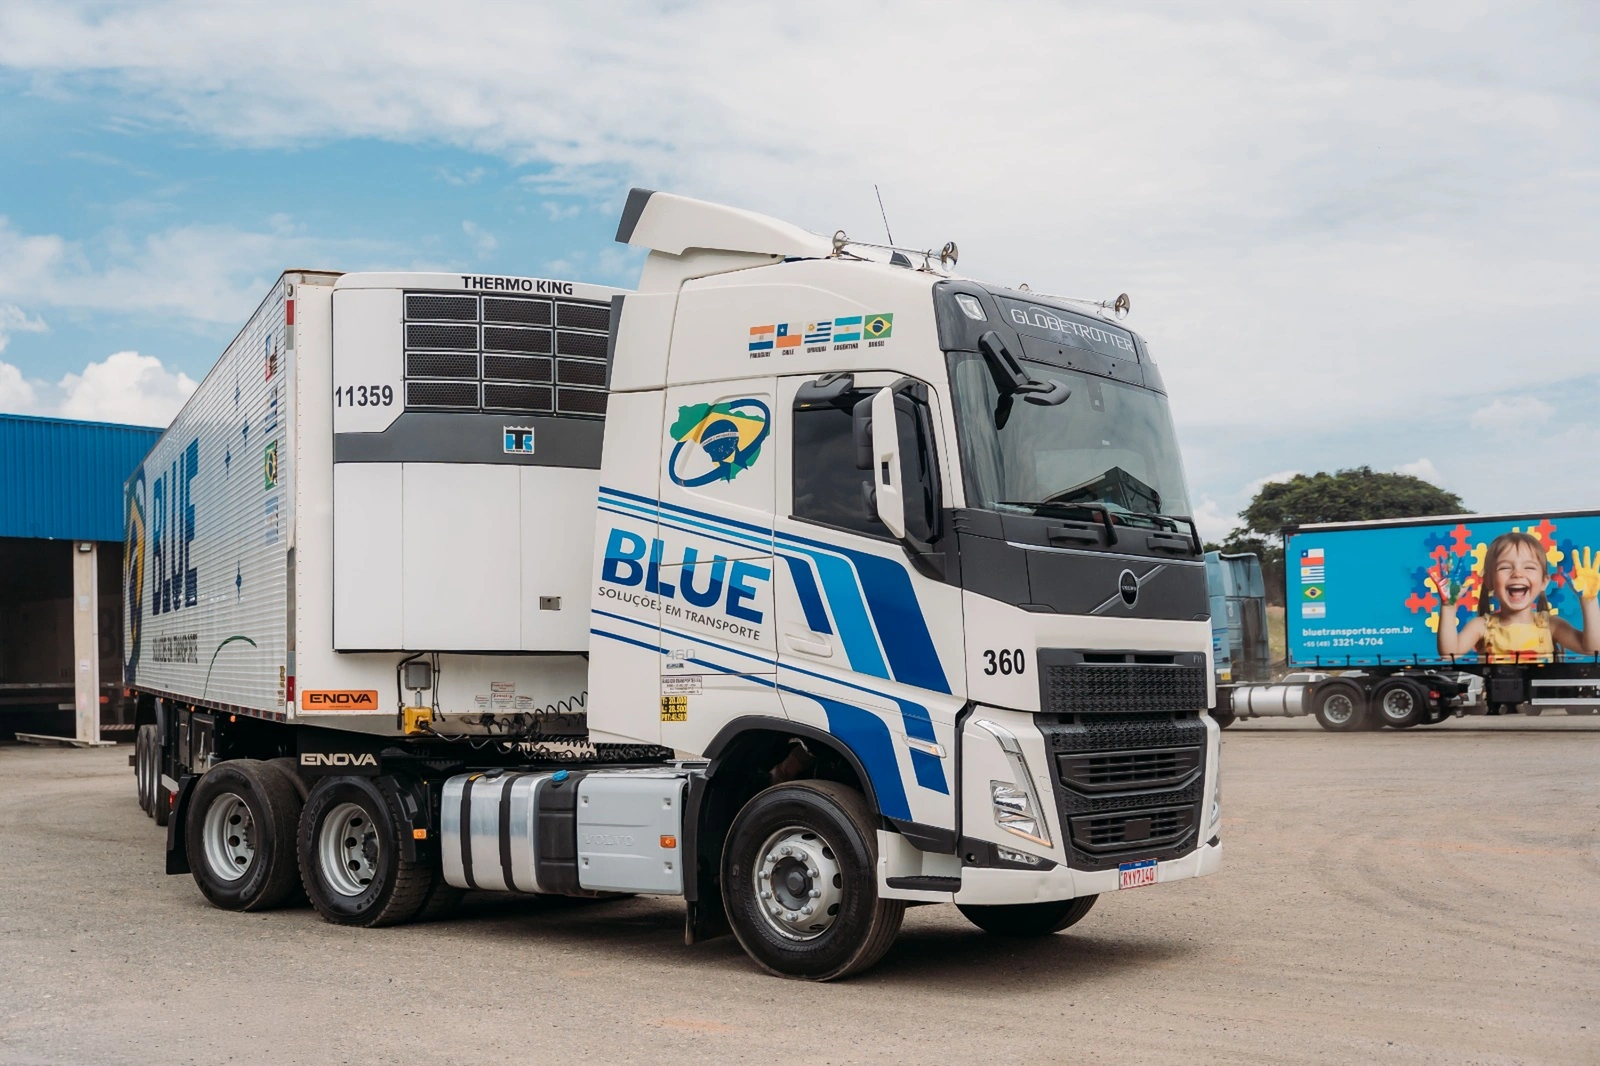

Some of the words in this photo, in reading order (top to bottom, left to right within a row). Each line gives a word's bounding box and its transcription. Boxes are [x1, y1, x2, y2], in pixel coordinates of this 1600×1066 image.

[461, 276, 532, 292] THERMO
[536, 280, 573, 295] KING
[1010, 308, 1134, 352] GLOBETROTTER
[833, 343, 859, 351] ARGENTINA
[335, 384, 393, 407] 11359
[152, 437, 199, 616] BLUE
[602, 528, 771, 624] BLUE
[598, 586, 662, 611] SOLUÇÕES
[665, 604, 681, 617] EM
[685, 610, 760, 640] TRANSPORTE
[1302, 626, 1414, 637] bluetransportes.com.br
[1332, 637, 1384, 647] 3321-4704
[983, 649, 1025, 675] 360
[310, 694, 372, 703] ENOVA
[300, 753, 378, 766] ENOVA
[581, 833, 634, 847] VOLVO
